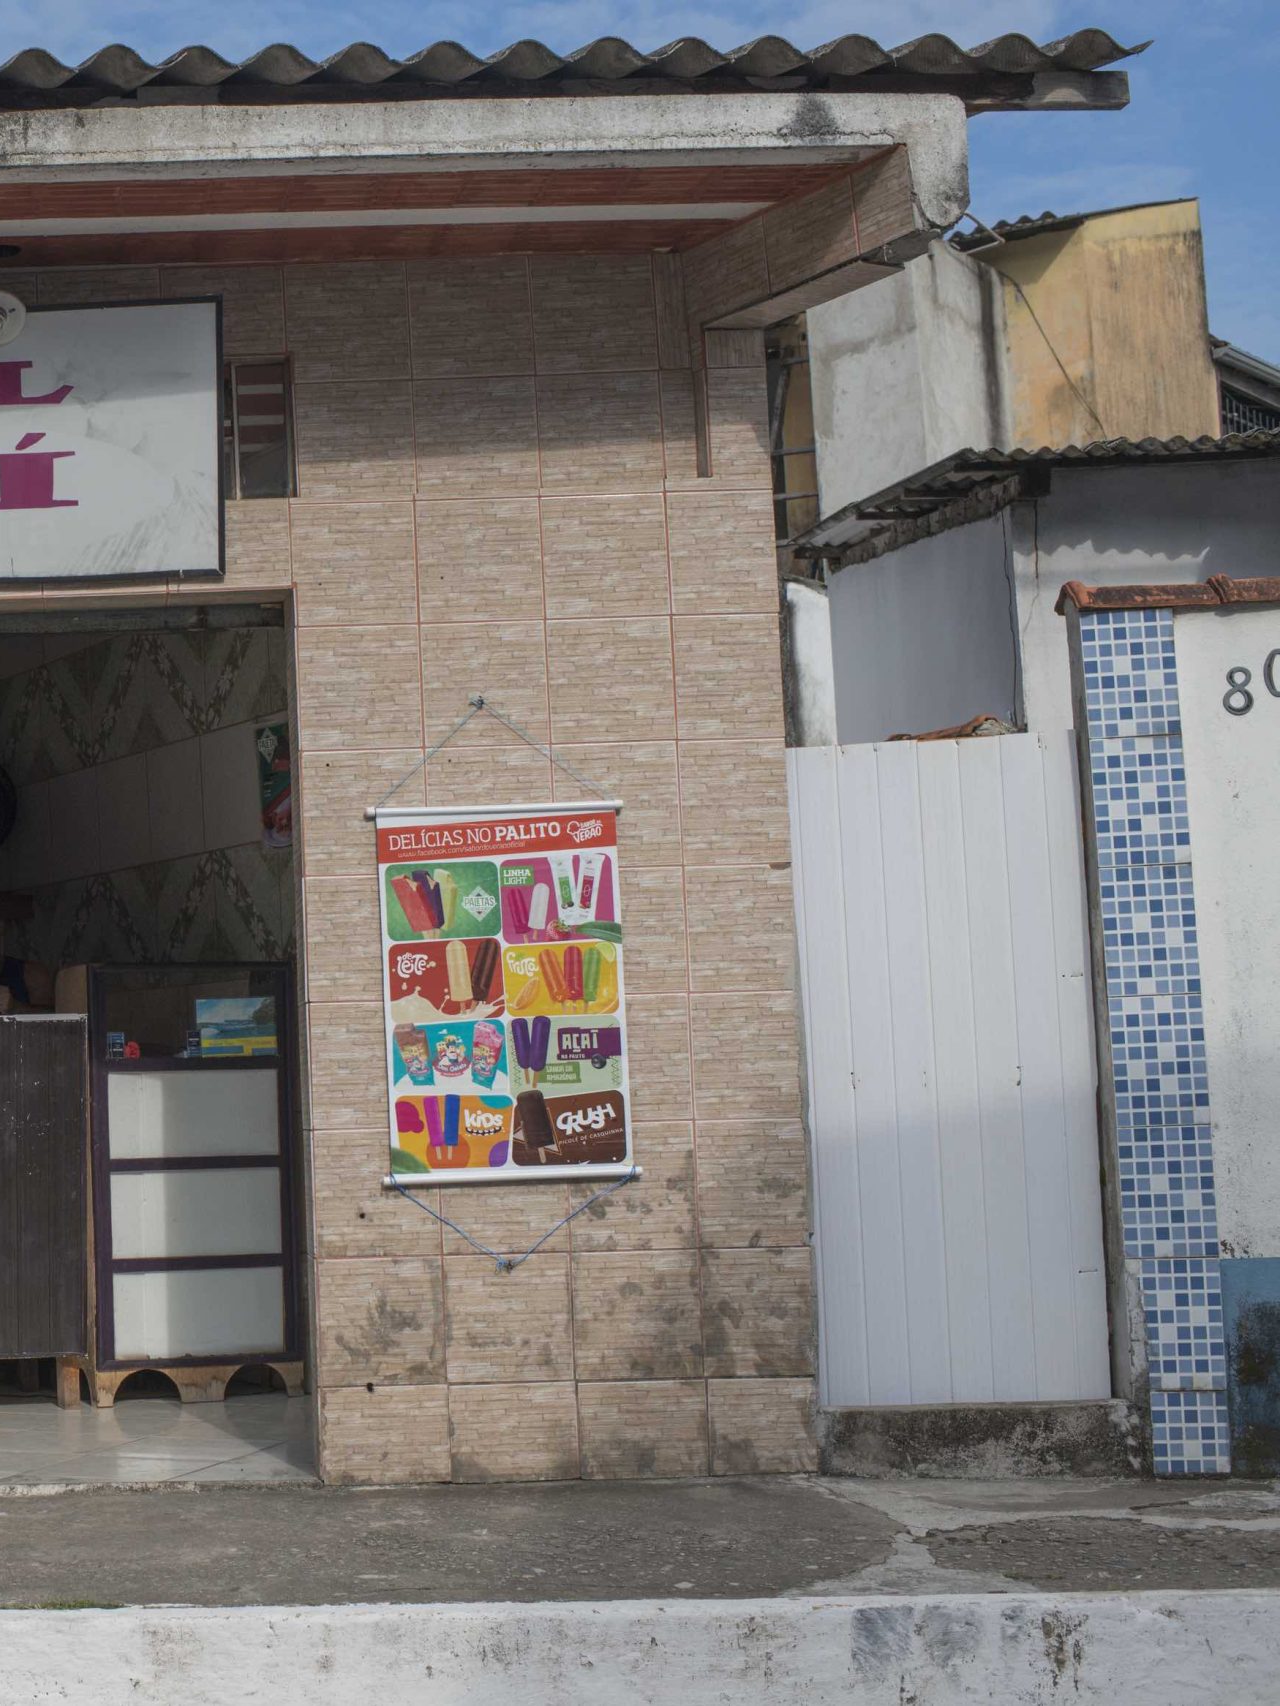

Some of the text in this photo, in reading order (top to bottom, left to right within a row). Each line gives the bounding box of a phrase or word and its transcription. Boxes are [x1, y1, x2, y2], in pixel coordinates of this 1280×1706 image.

[387, 821, 561, 851] DELÍCIAS NO PALITO
[503, 868, 531, 877] LINHA
[503, 877, 527, 885] LIGHT
[463, 896, 495, 907] PALETAS
[556, 1103, 617, 1136] CRUSH
